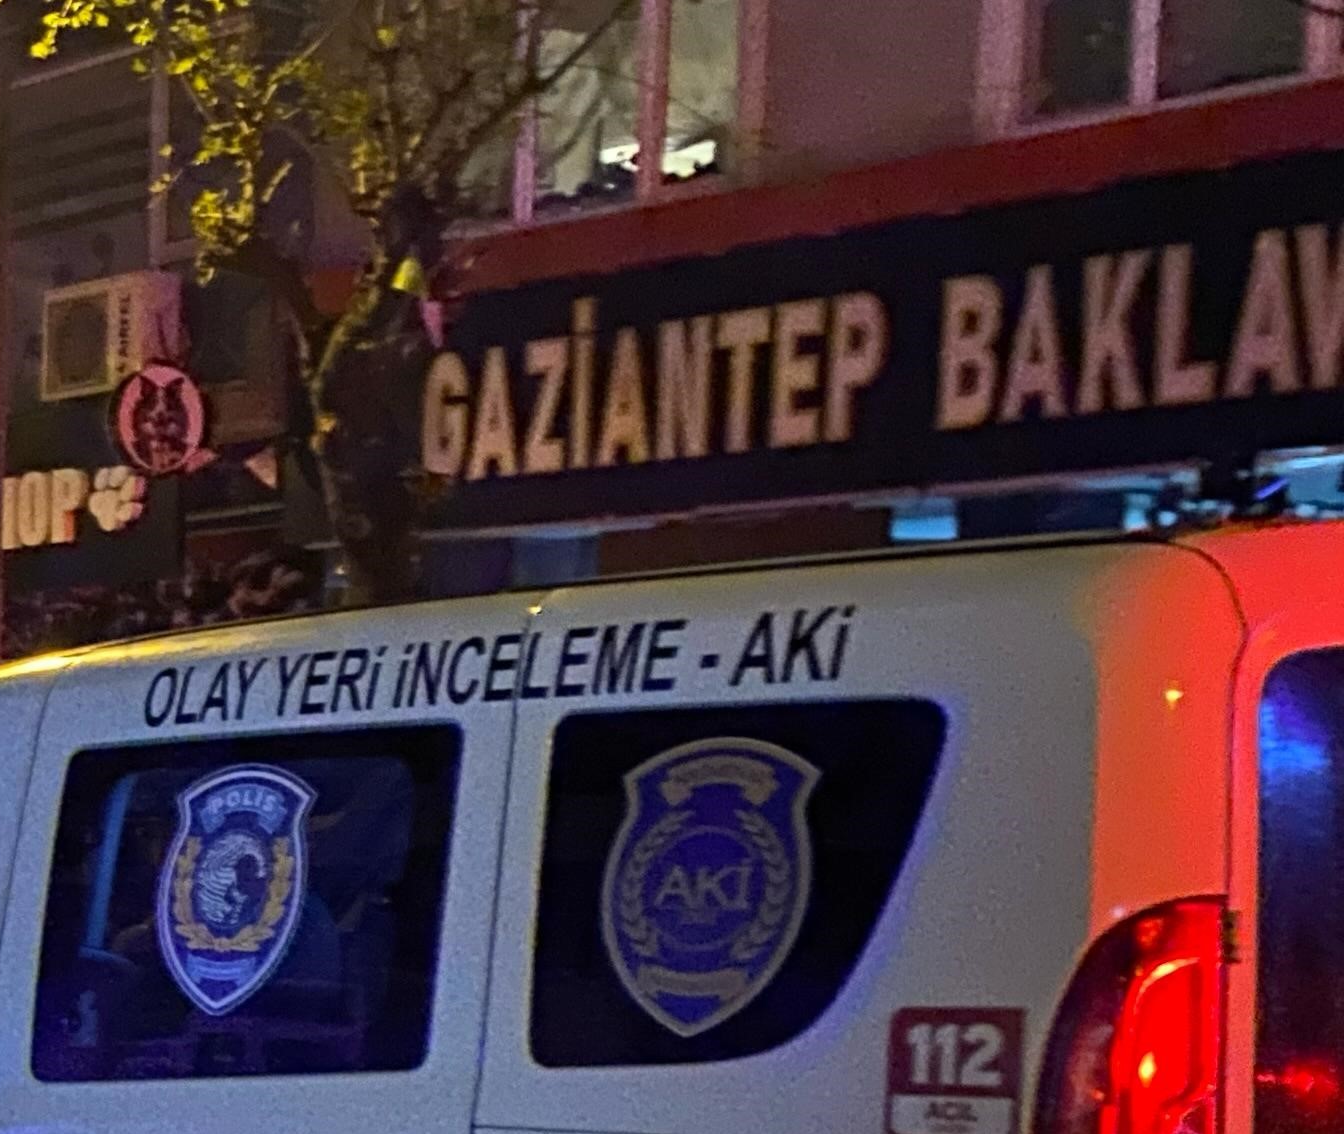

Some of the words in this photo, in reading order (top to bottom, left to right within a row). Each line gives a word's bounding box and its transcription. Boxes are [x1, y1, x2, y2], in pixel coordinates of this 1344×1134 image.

[422, 290, 892, 481] GAZİANTEP
[143, 657, 267, 728] OLAY
[906, 1023, 1005, 1087] 112
